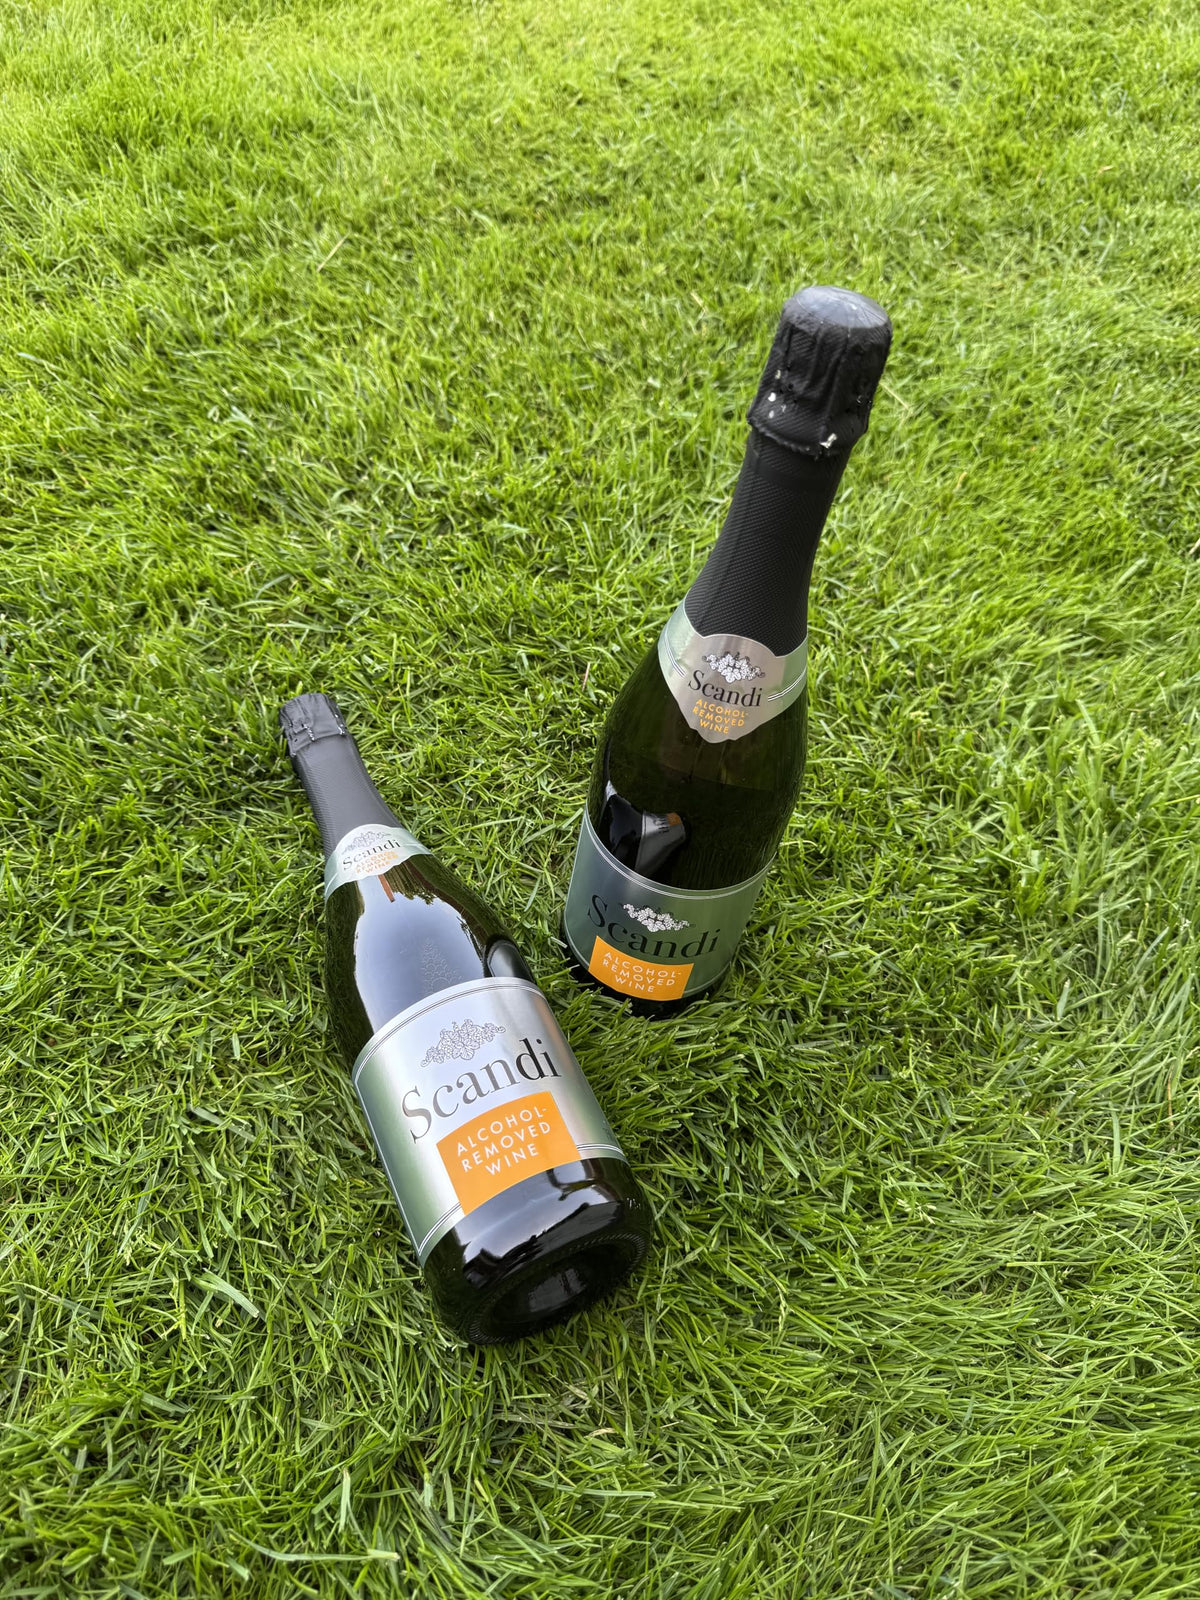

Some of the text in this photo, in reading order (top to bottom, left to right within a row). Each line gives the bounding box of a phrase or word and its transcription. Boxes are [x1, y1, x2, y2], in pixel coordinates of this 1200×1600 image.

[688, 670, 762, 707] Scandi
[692, 707, 745, 727] REMOVED
[696, 699, 749, 718] ALCOHOL-
[700, 719, 729, 734] WINE
[343, 839, 401, 870] Scandi
[588, 894, 721, 959] Scandi
[602, 959, 675, 986] REMOVED
[604, 952, 681, 978] ALCOHOL-
[615, 975, 655, 992] WINE
[402, 1037, 562, 1144] Scandi
[457, 1106, 547, 1157] ALCOHOL-
[461, 1122, 551, 1172] REMOVED
[485, 1143, 539, 1176] WINE
